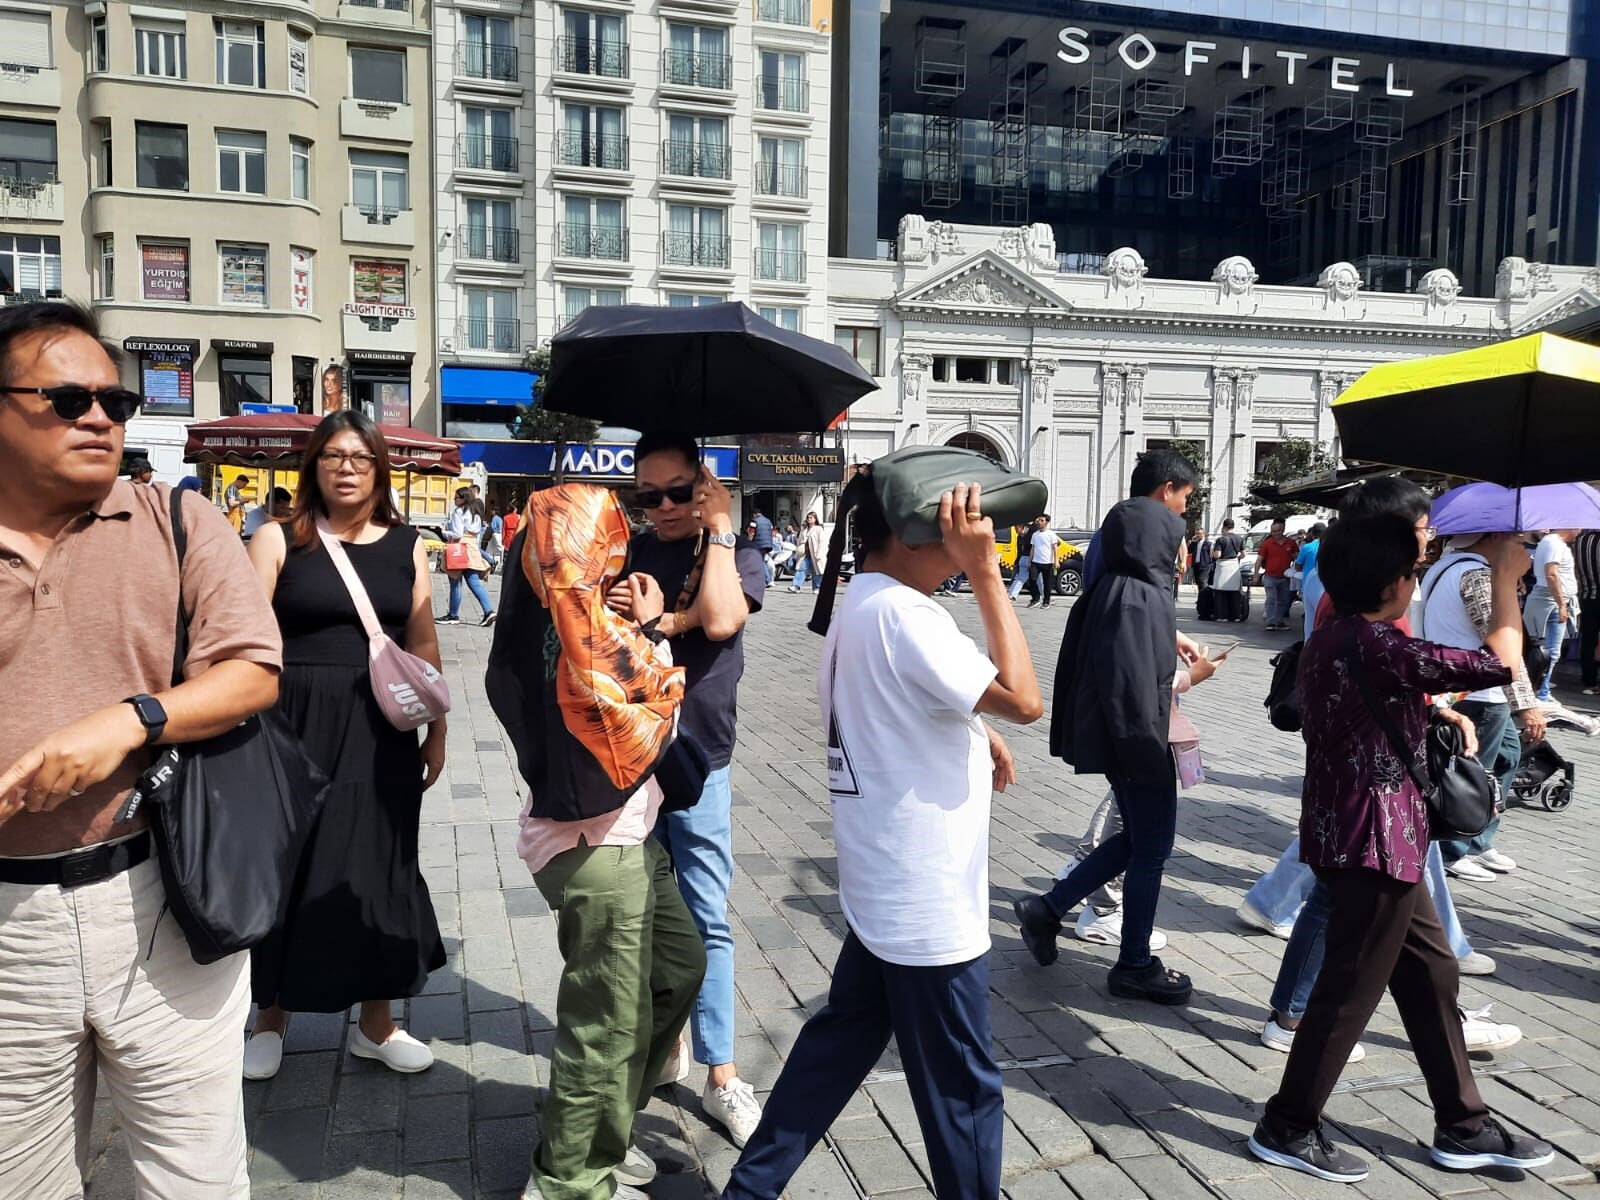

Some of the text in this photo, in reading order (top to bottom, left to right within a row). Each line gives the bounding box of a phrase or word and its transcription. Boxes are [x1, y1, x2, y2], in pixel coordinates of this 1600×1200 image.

[1057, 26, 1413, 97] SOFITEL
[151, 278, 183, 289] EĞİTİM
[294, 270, 308, 307] THY
[345, 303, 415, 317] FLIGHT TICKETS
[126, 342, 191, 352] REFLEXOLOGY
[224, 341, 257, 349] KUAFÖR
[354, 352, 405, 360] HAIRDRESSER
[549, 447, 634, 474] MADO
[747, 453, 769, 463] CVK
[808, 455, 840, 464] HOTEL
